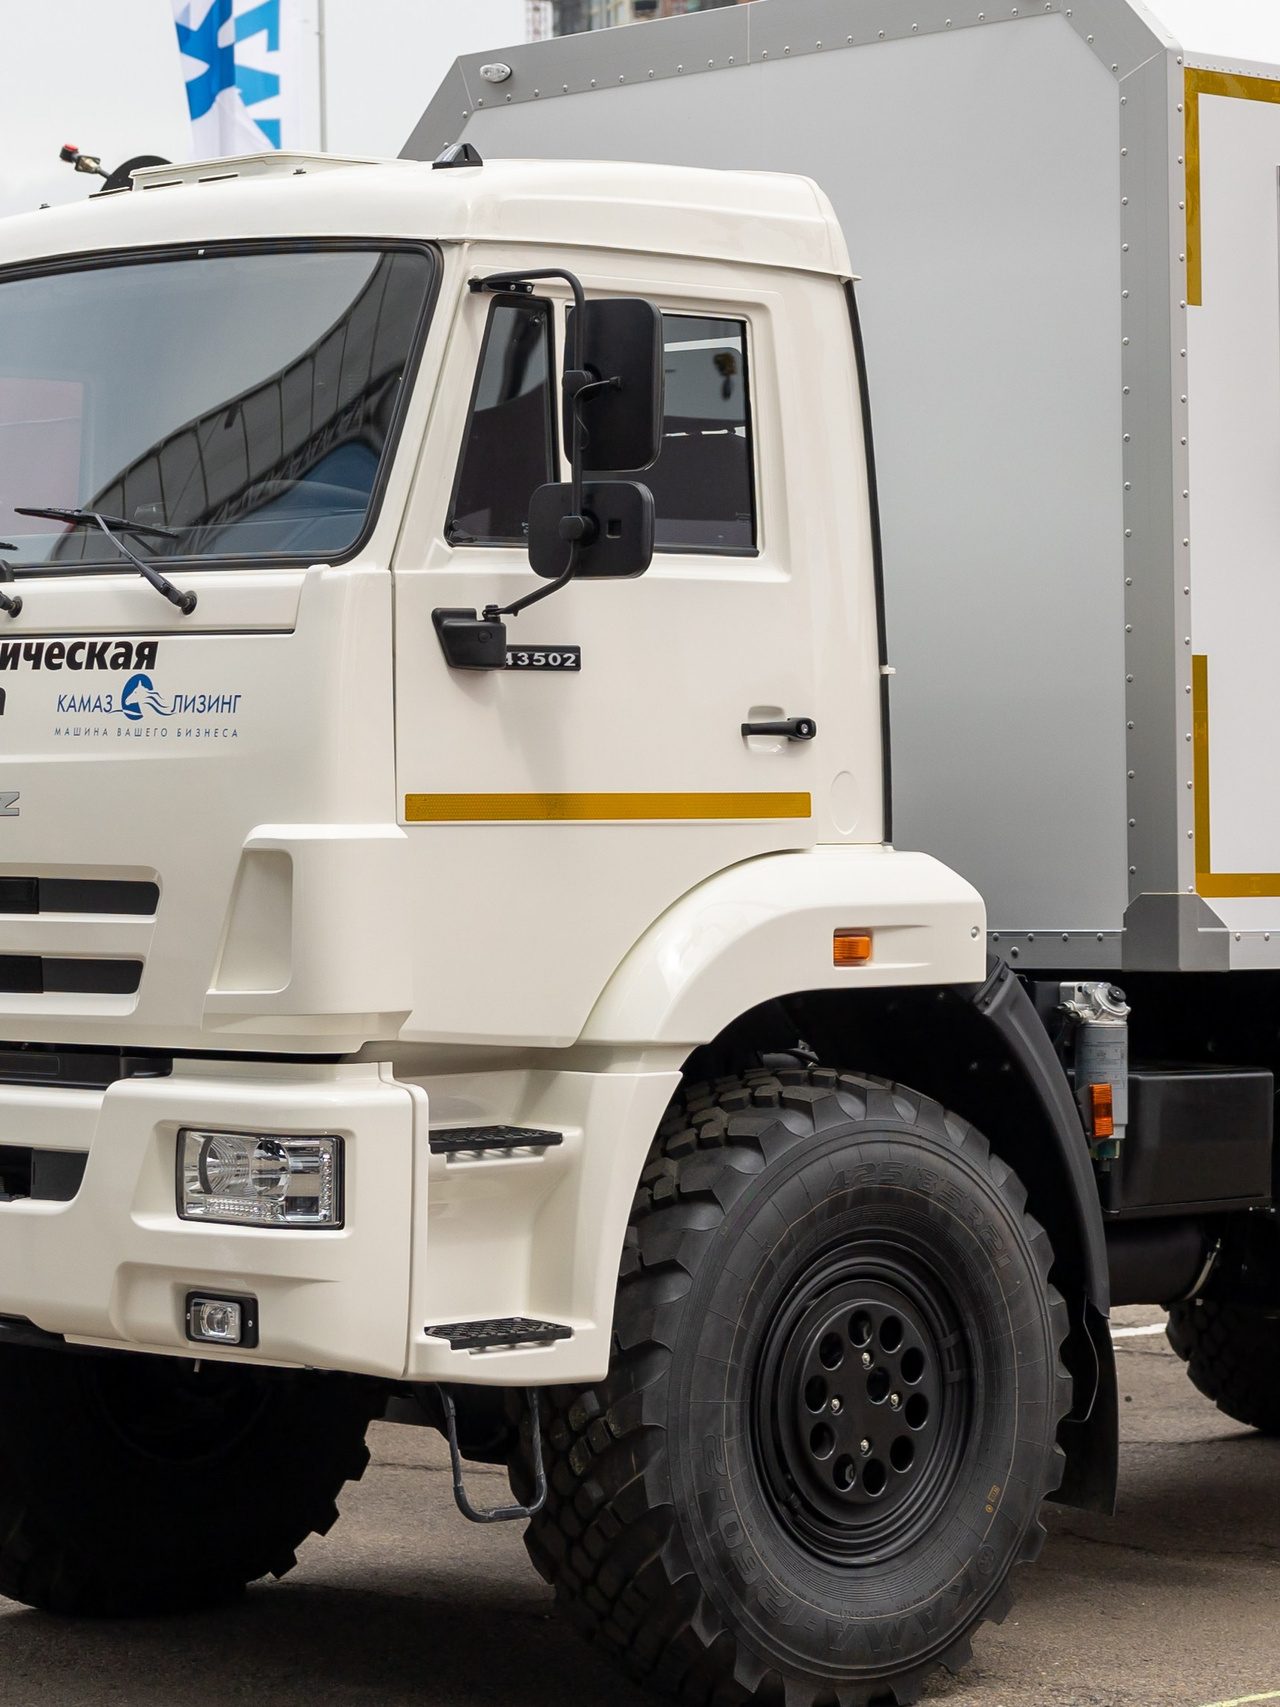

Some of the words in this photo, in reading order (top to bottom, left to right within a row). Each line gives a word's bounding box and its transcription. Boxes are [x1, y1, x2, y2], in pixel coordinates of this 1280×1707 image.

[505, 652, 577, 667] 43502
[56, 694, 113, 714] КАМАЗ
[170, 694, 242, 714] ЛИЗИНГ
[54, 727, 109, 737] МАШИНА
[116, 727, 168, 738] ВАШЕГО
[176, 728, 239, 738] БИЗНЕСА
